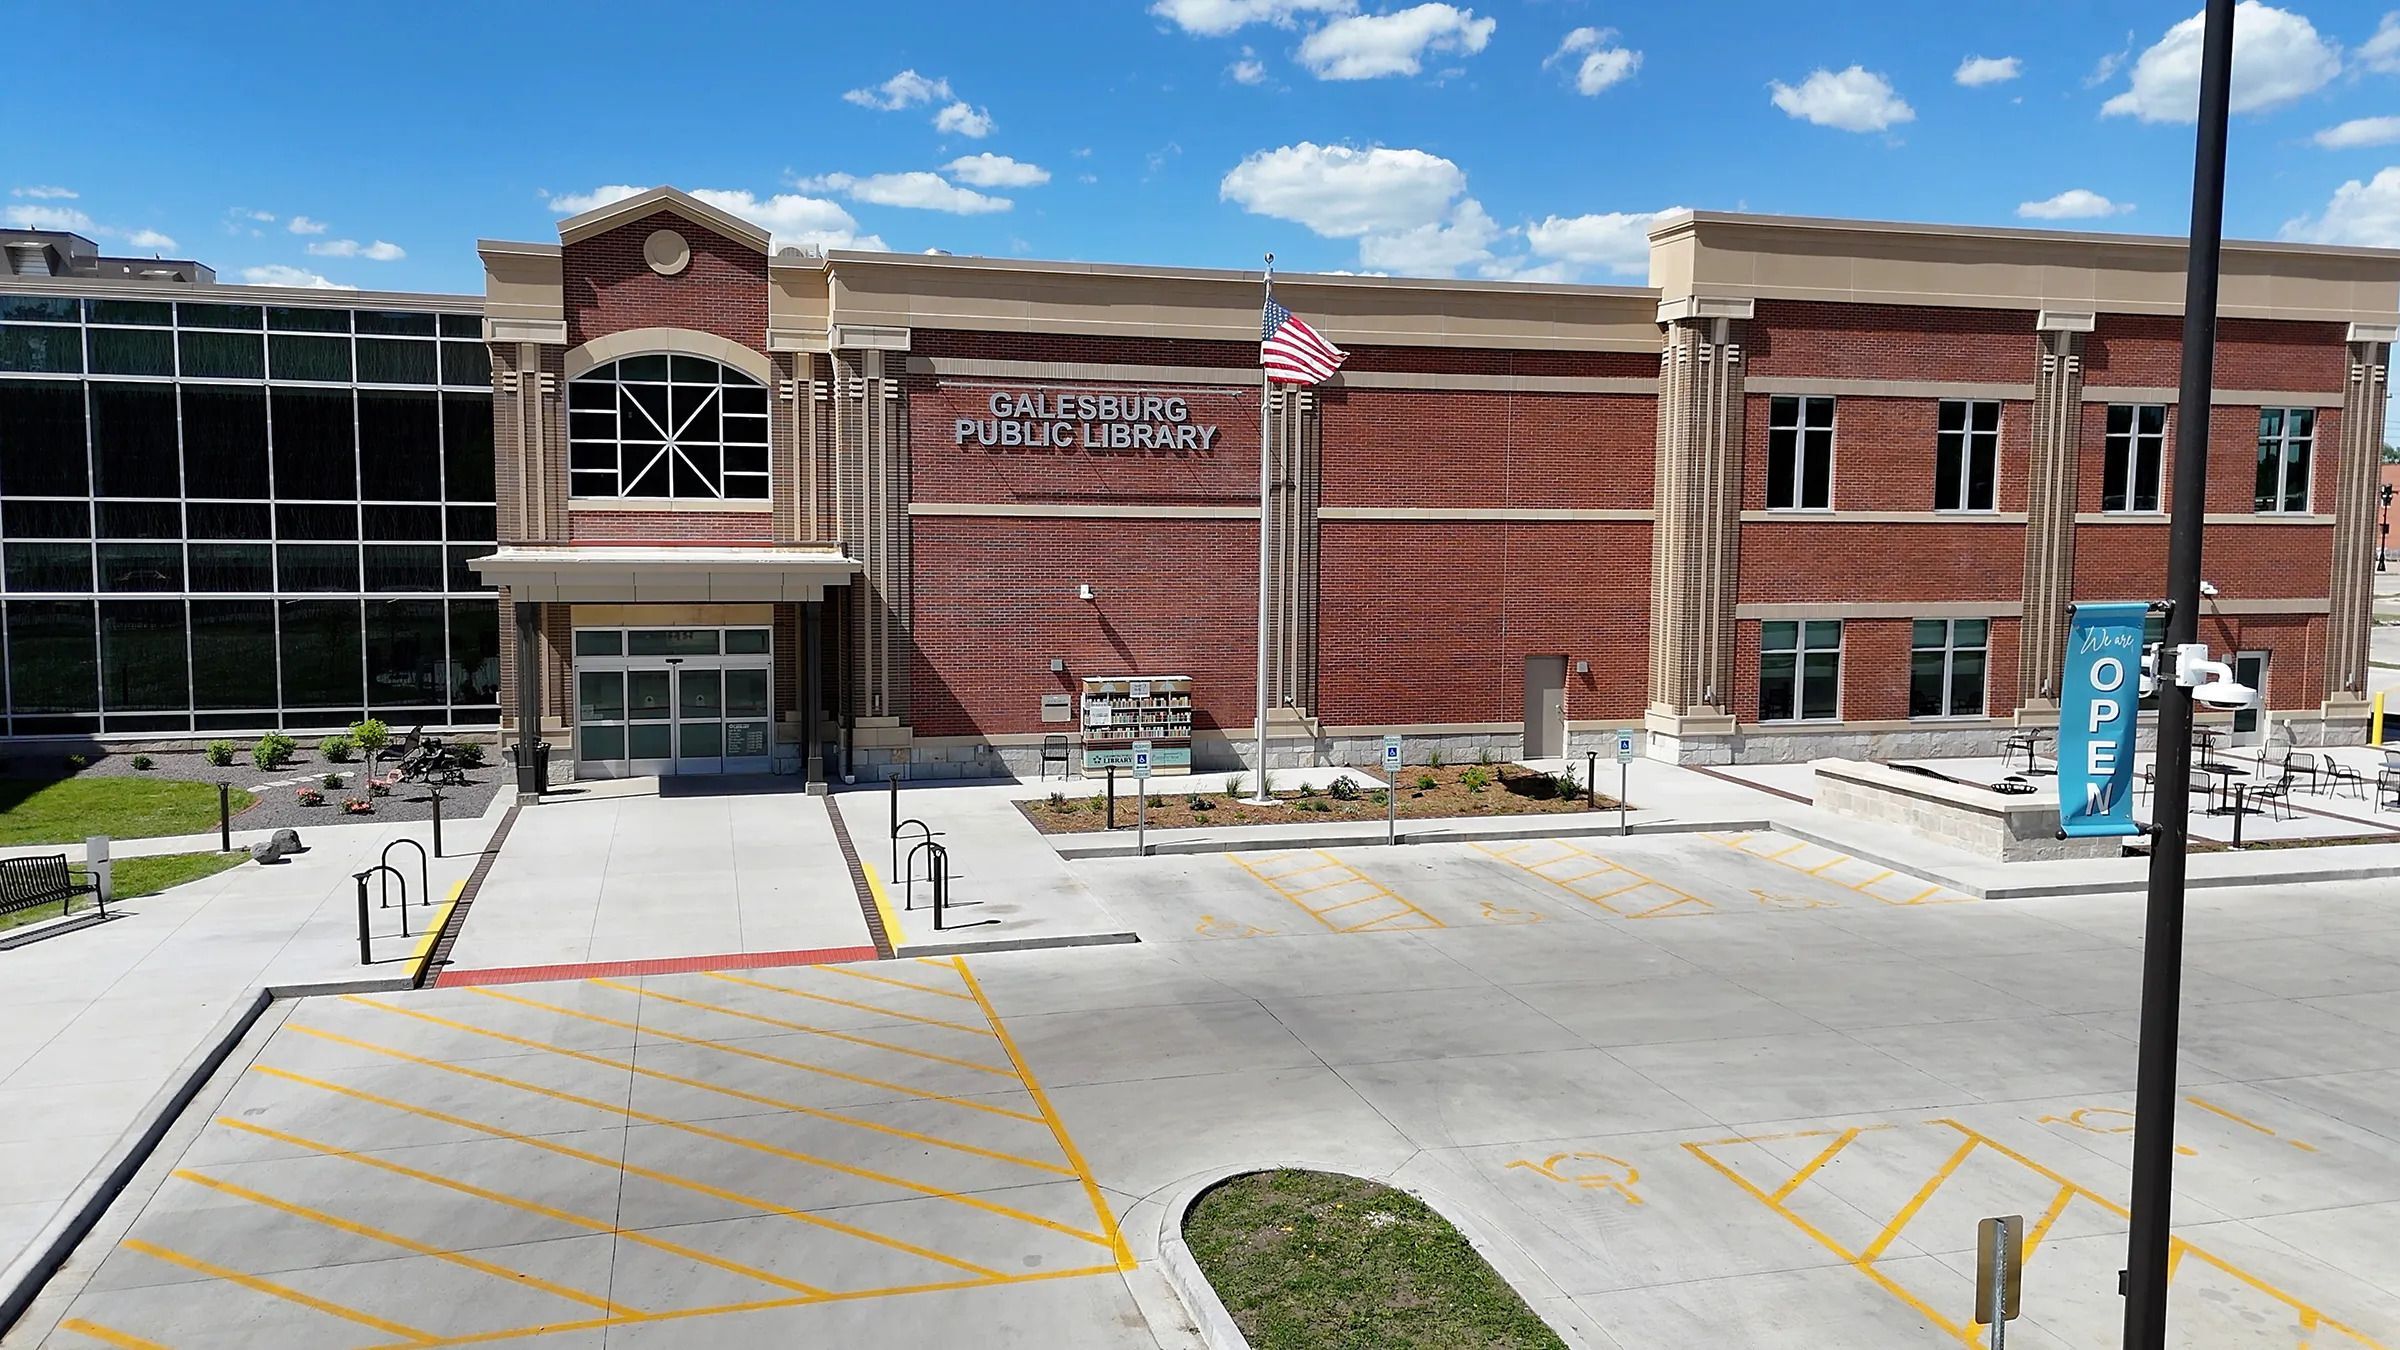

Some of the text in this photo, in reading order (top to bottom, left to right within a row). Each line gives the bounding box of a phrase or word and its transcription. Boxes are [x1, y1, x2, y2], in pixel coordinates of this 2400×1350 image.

[988, 392, 1187, 422] GALESBURG
[955, 419, 1217, 450] PUBLIC LIBRARY
[2080, 625, 2135, 654] We are
[2085, 657, 2125, 816] OPEN
